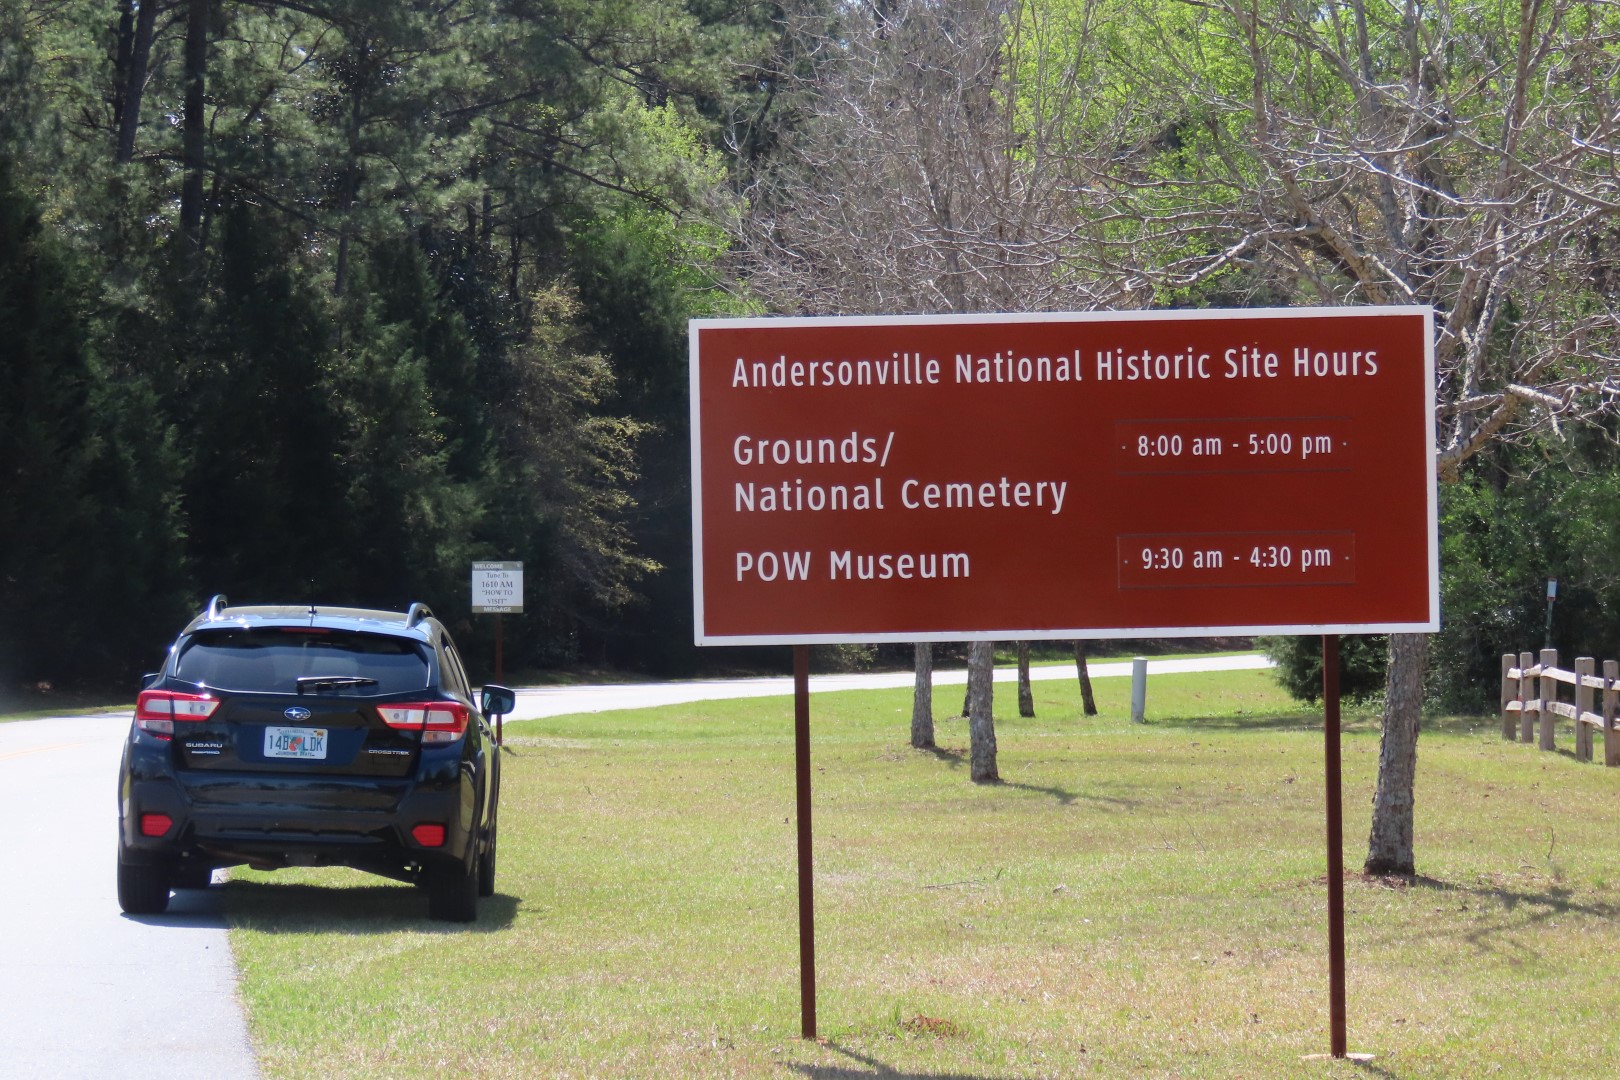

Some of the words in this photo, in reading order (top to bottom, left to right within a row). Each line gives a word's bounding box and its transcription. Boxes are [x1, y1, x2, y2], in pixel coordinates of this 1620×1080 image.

[731, 352, 940, 388] Andersonville
[955, 349, 1083, 384] National
[1096, 346, 1211, 381] Historic
[1224, 345, 1279, 379] Site
[1293, 347, 1379, 377] Hours
[733, 431, 895, 468] Grounds/
[1137, 434, 1183, 457] 8:00
[1192, 437, 1222, 456] am
[1248, 433, 1292, 455] 5:00
[1302, 435, 1332, 460] pm
[735, 477, 884, 512] National
[900, 476, 1068, 515] Cemetery
[736, 551, 812, 582] POW
[830, 549, 971, 580] Museum
[1140, 547, 1184, 570] 9:30
[1193, 550, 1223, 569] am
[1249, 546, 1292, 568] 4:30
[1301, 548, 1331, 573] pm
